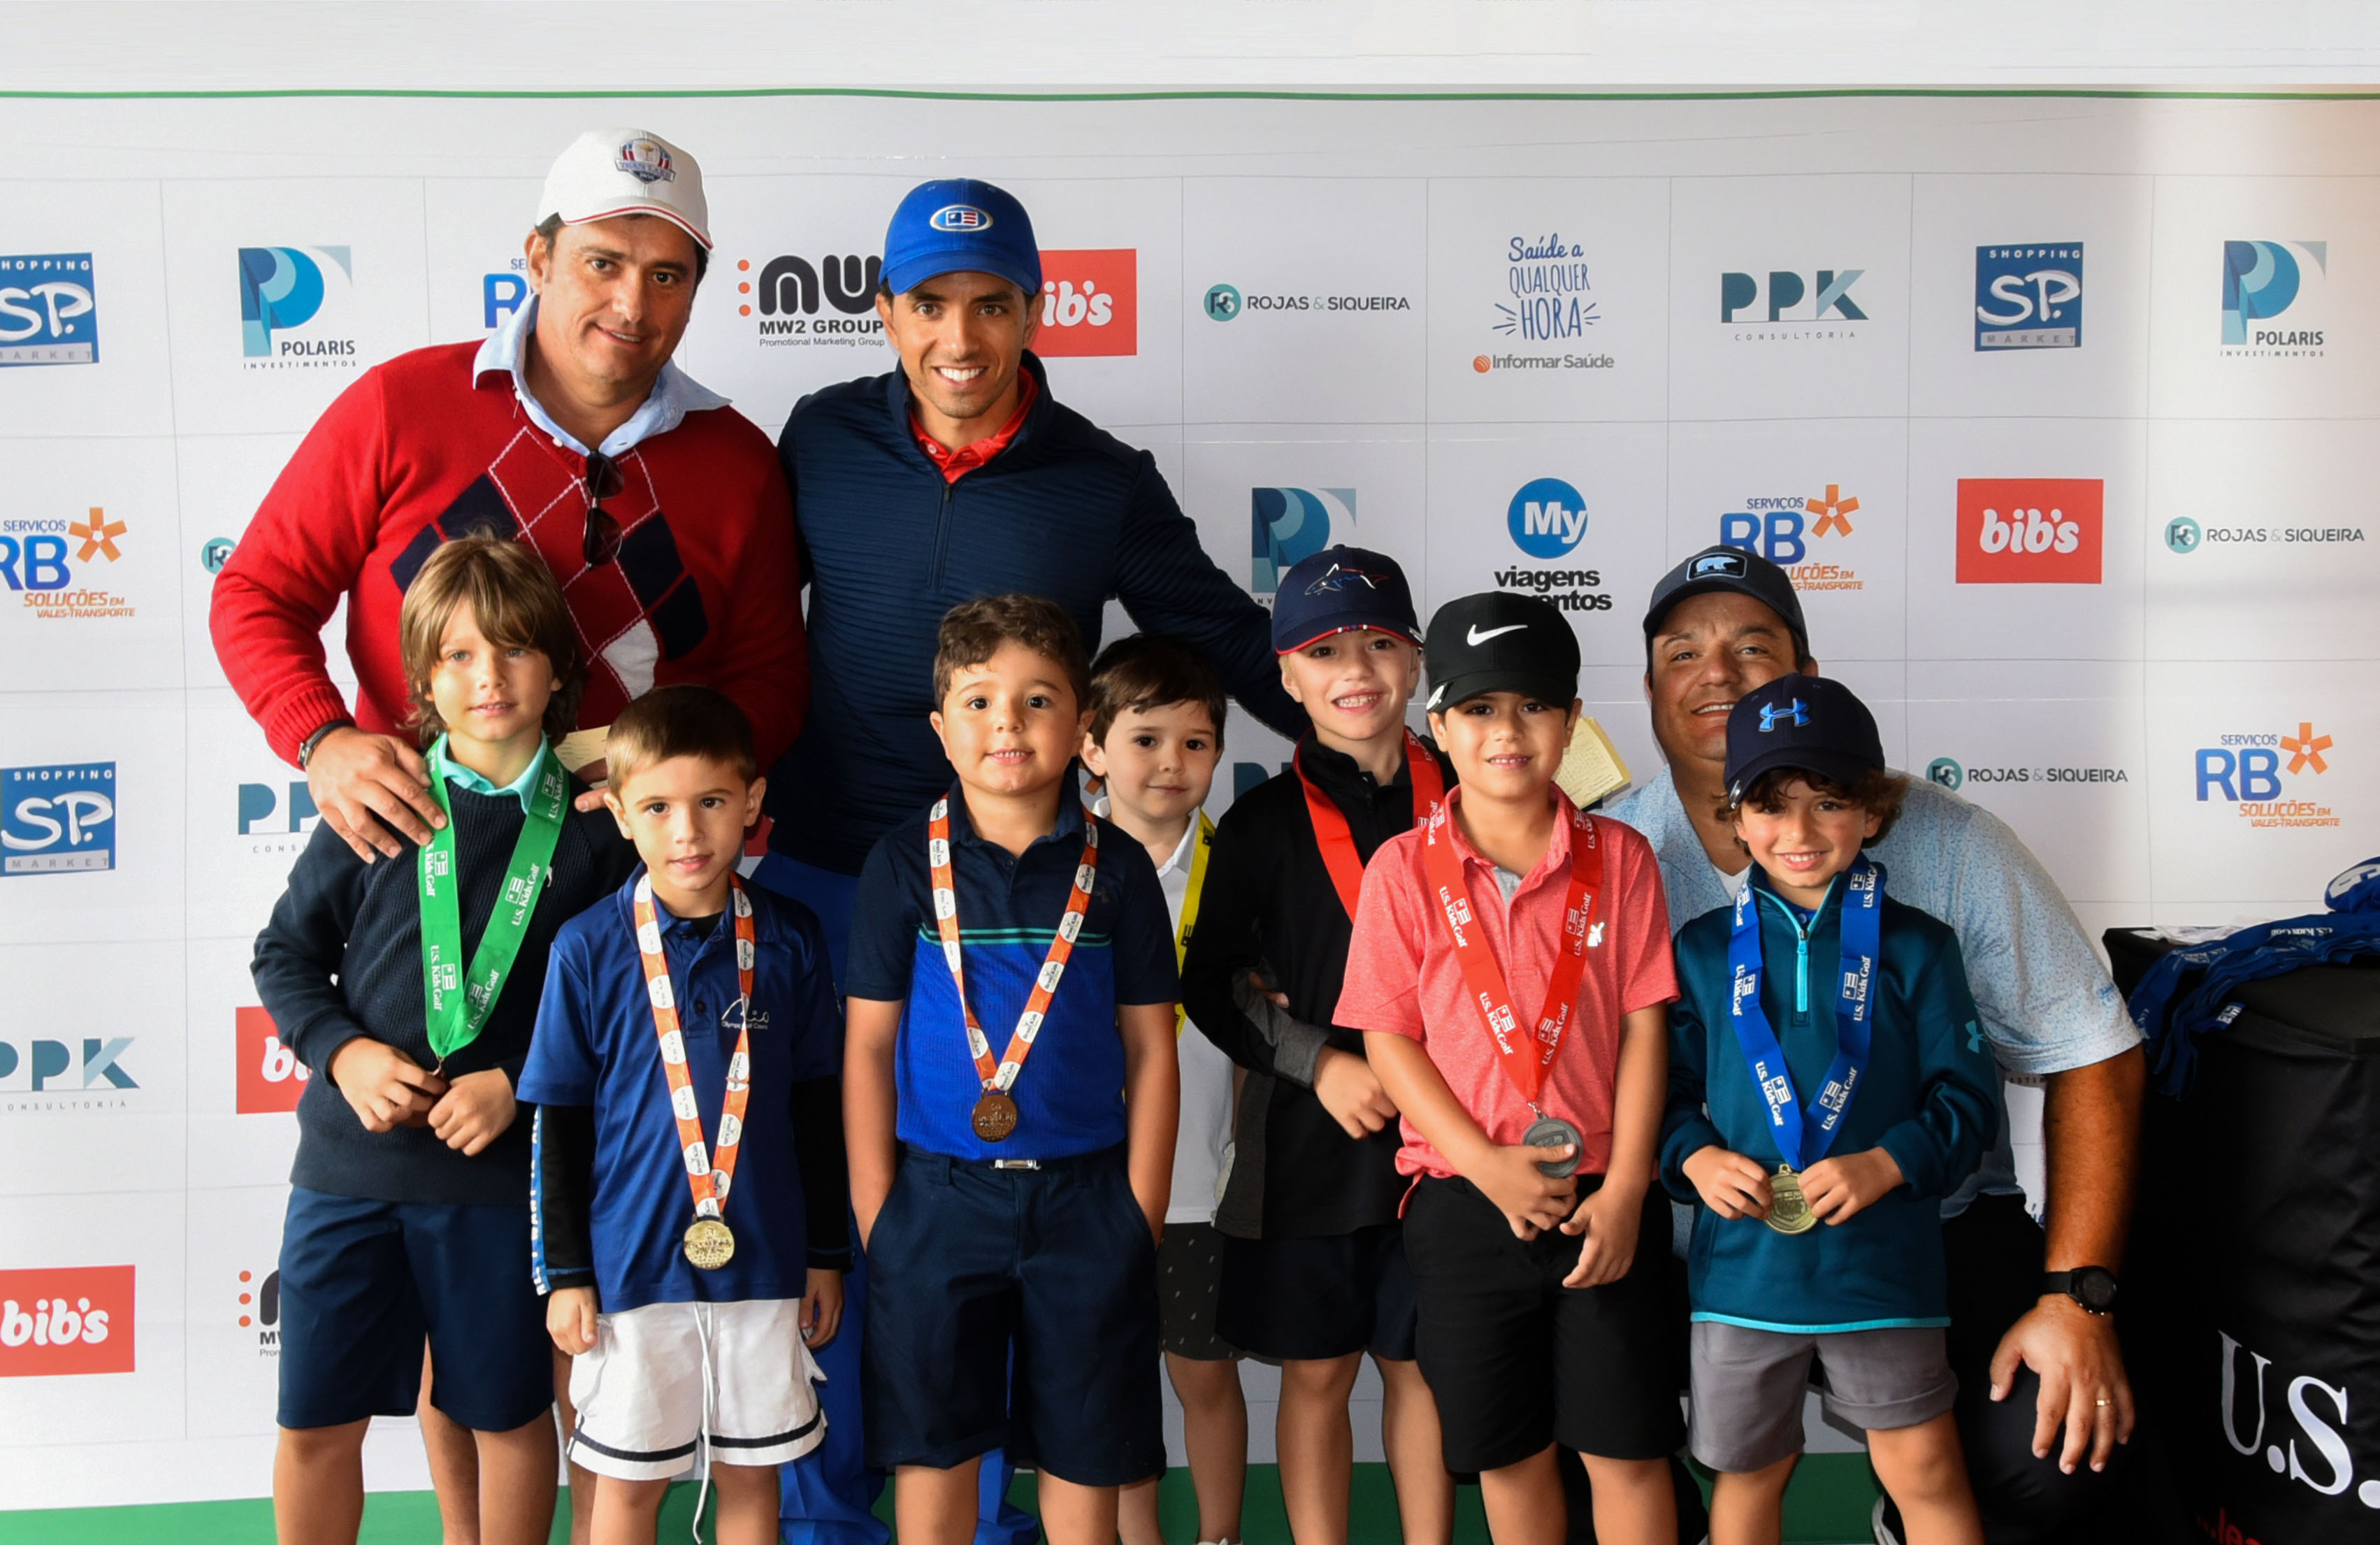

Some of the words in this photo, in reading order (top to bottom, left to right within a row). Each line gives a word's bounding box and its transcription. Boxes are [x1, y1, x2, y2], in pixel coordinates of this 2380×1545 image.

[1508, 233, 1567, 263] Saúde
[1571, 243, 1585, 259] a
[1989, 250, 2080, 259] SHOPPING
[1, 260, 90, 271] HOPPING
[1509, 264, 1590, 299] QUALQUER
[483, 273, 528, 329] R
[1042, 280, 1113, 326] ib's
[1247, 296, 1309, 311] ROJAS
[1313, 296, 1325, 310] &
[1327, 295, 1411, 311] SIQUEIRA
[1721, 269, 1870, 324] PPK
[1521, 297, 1583, 340] HORA
[759, 320, 807, 335] MW2
[812, 319, 884, 333] GROUP
[759, 338, 811, 347] Promotional
[814, 338, 856, 347] Marketing
[858, 338, 885, 347] Group
[1735, 331, 1856, 341] CONSULTORIA
[1986, 334, 2075, 344] MARKET
[2256, 331, 2323, 347] POLARIS
[0, 351, 92, 359] ARKET
[282, 340, 356, 356] POLARIS
[1492, 354, 1561, 370] Informar
[1564, 353, 1615, 370] Saúde
[1747, 497, 1804, 510] SERVIÇOS
[3, 519, 66, 533] SERVIÇOS
[1524, 501, 1587, 544] My
[1720, 511, 1805, 565] RB
[1979, 509, 2079, 554] bib's
[2207, 529, 2267, 542] ROJAS
[2271, 529, 2281, 541] &
[2284, 528, 2365, 542] SIQUEIRA
[0, 535, 71, 591] RB
[1784, 562, 1840, 580] UÇÕES
[1840, 570, 1854, 579] EM
[1494, 565, 1601, 593] viagens
[1791, 581, 1863, 591] ES-TRANSPORTE
[24, 589, 109, 608] SOLUÇÕES
[110, 597, 125, 605] EM
[1534, 590, 1613, 611] entos
[37, 607, 136, 618] VALES-TRANSPORTE
[2221, 734, 2278, 747] SERVIÇOS
[14, 770, 113, 781] SHOPPING
[1968, 768, 2029, 782] ROJAS
[2033, 768, 2043, 782] &
[2047, 768, 2128, 782] SIQUEIRA
[2196, 748, 2282, 801] RB
[238, 781, 319, 835] PP
[2239, 799, 2316, 819] SOLUÇÕES
[2317, 807, 2331, 816] EM
[2251, 817, 2341, 827] VALES-TRANSPORTE
[12, 858, 108, 868] MARKET
[426, 875, 436, 898] Golf
[8, 1101, 127, 1111] ONSULTORIA
[1, 1298, 109, 1347] bib's
[2219, 1330, 2380, 1509] U.S.
